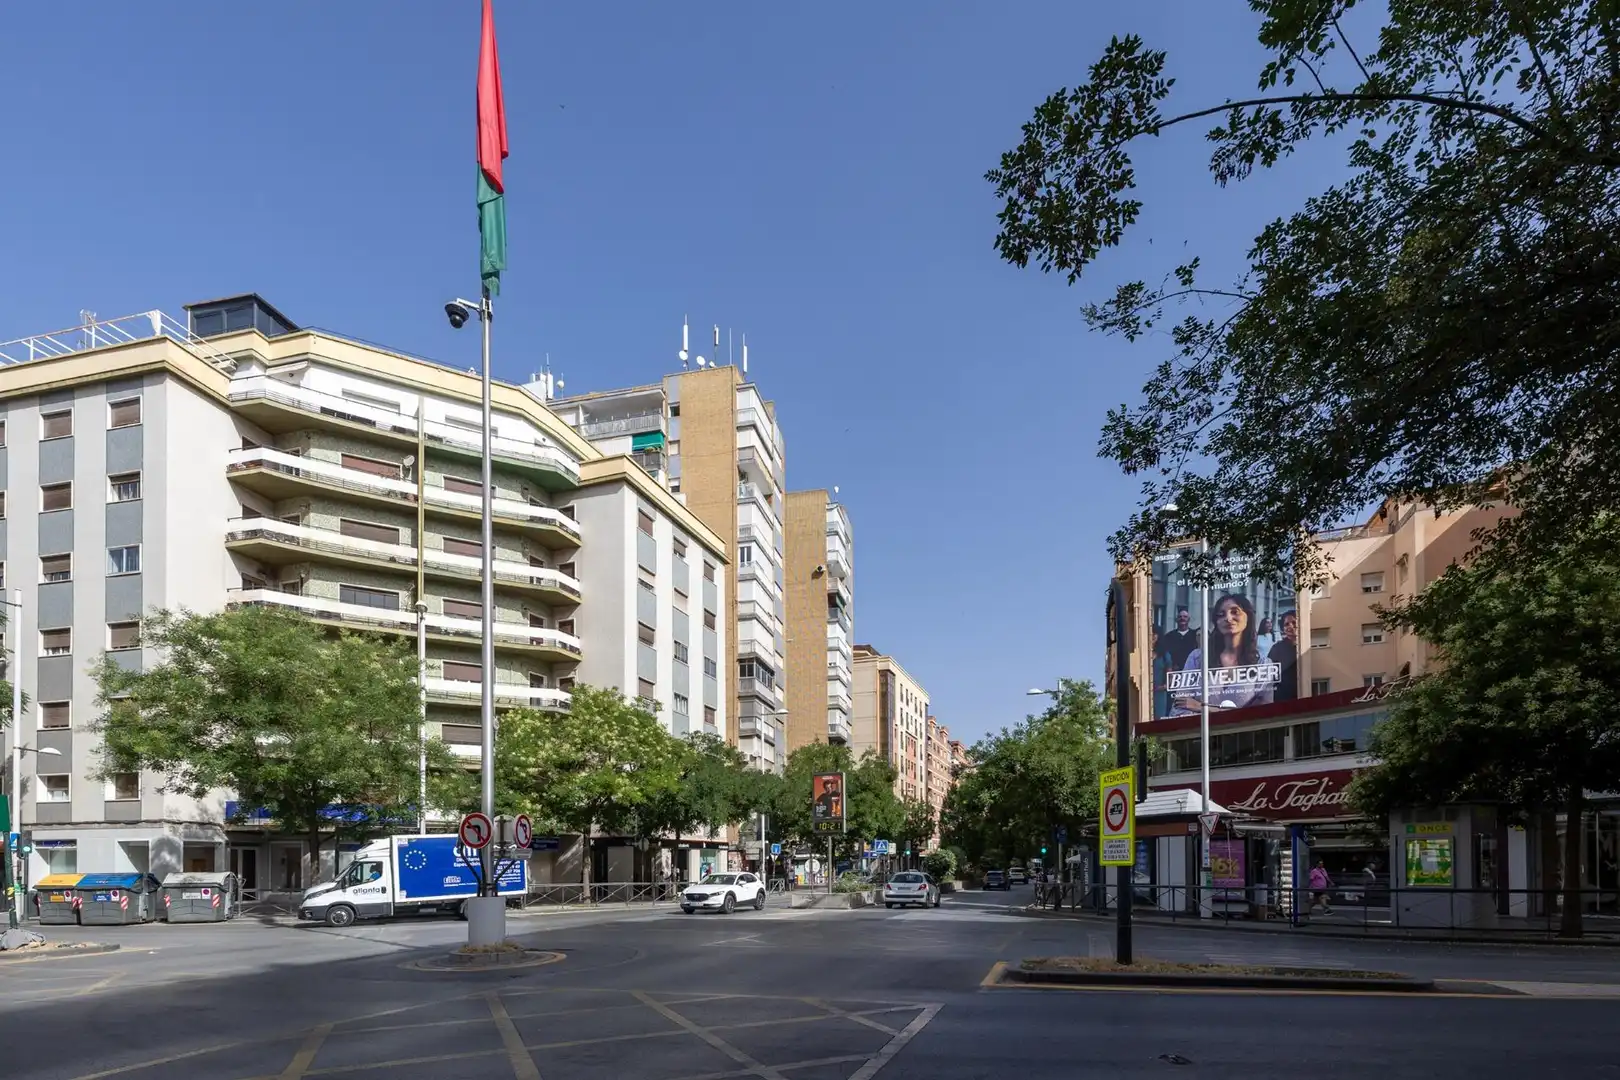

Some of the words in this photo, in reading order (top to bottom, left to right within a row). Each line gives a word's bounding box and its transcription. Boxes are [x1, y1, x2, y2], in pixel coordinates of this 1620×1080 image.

[1238, 562, 1250, 570] en
[1177, 578, 1185, 587] el
[1211, 579, 1249, 591] mundo?
[1104, 771, 1130, 784] ATENCIÓN
[1227, 782, 1268, 810] La
[1419, 824, 1448, 833] ONCE
[353, 886, 381, 895] atlanta
